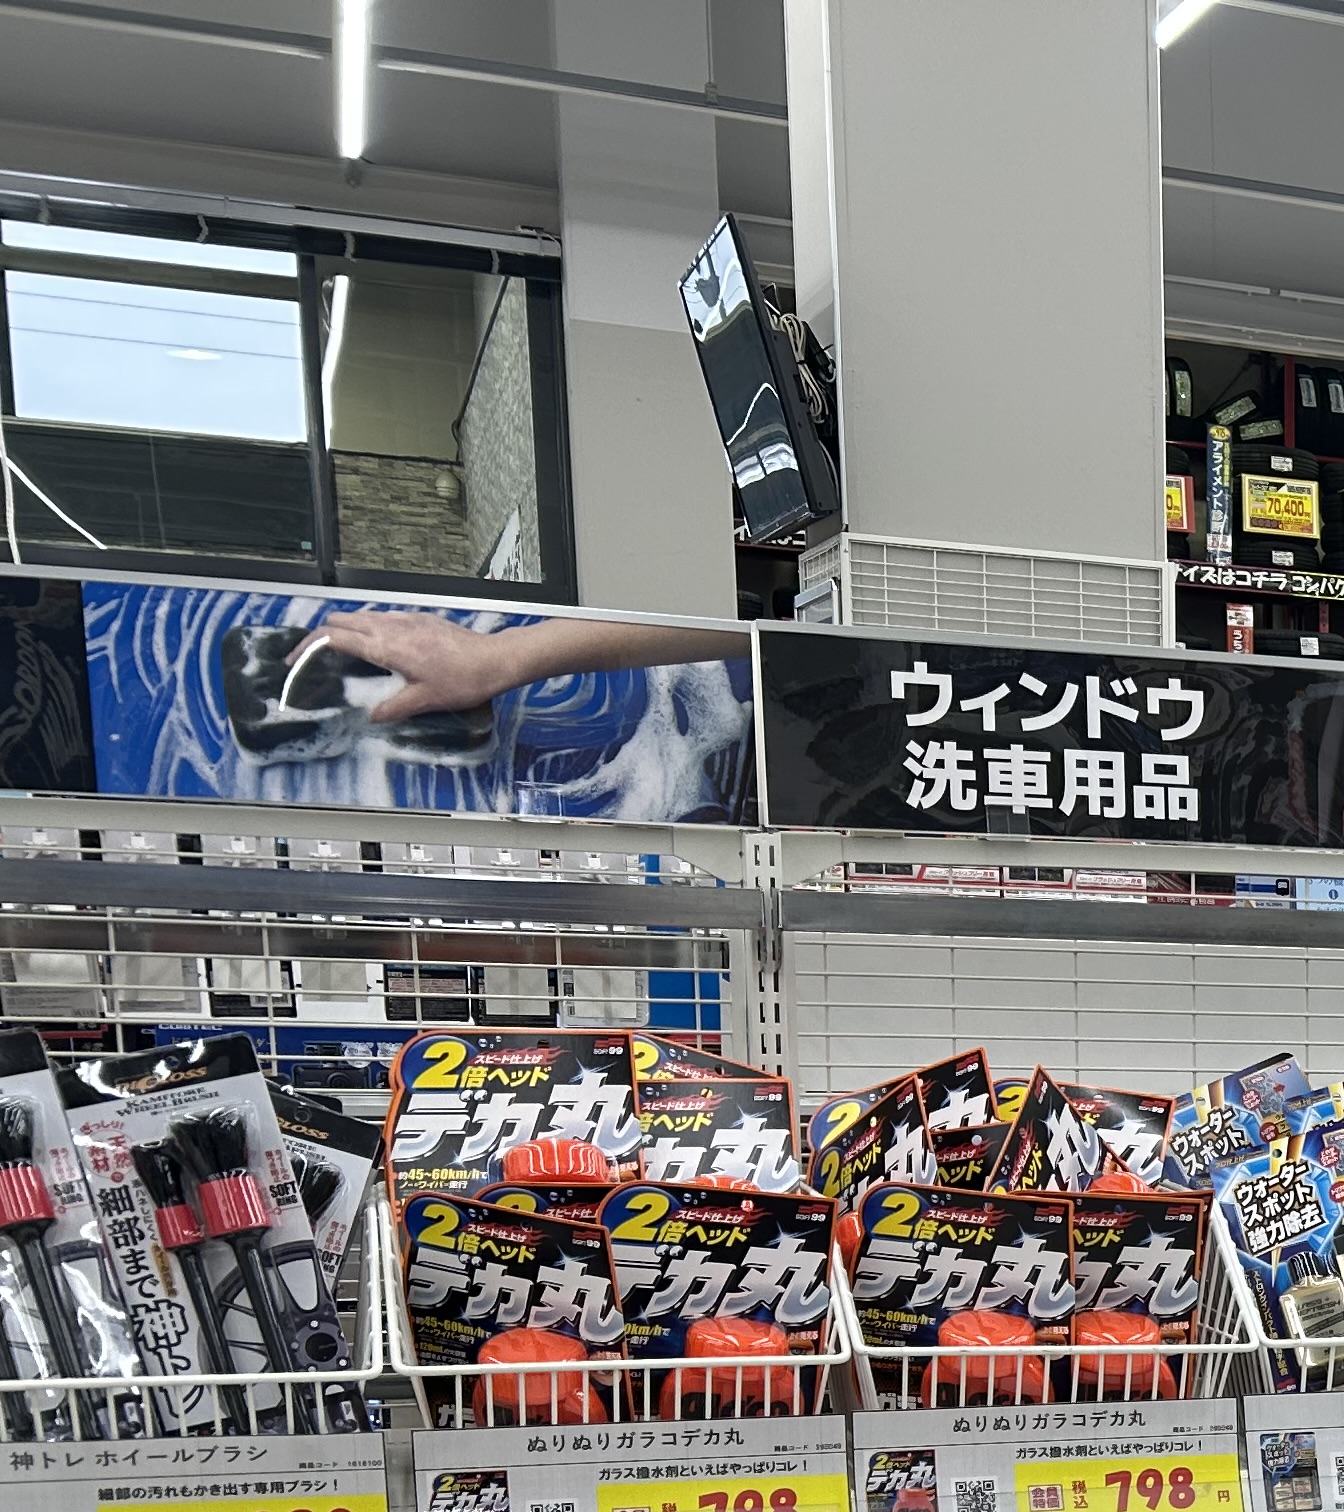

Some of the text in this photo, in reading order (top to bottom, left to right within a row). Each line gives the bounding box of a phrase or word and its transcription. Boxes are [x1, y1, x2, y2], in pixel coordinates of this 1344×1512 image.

[890, 661, 1205, 741] ウィンドウ
[902, 739, 1199, 821] 洗車用品
[1236, 1161, 1310, 1206] ウォーター
[98, 1184, 161, 1296] 細部まで
[1248, 1205, 1326, 1255] 強力除去
[407, 1244, 624, 1345] デカ丸
[853, 1237, 1077, 1320] デカ丸
[528, 1427, 745, 1453] ぬりぬりガラコデカ丸
[953, 1409, 1147, 1434] ぬりぬりガラコデカ丸
[10, 1446, 269, 1471] 神トレ ホイールブラシ
[1105, 1466, 1196, 1512] 798
